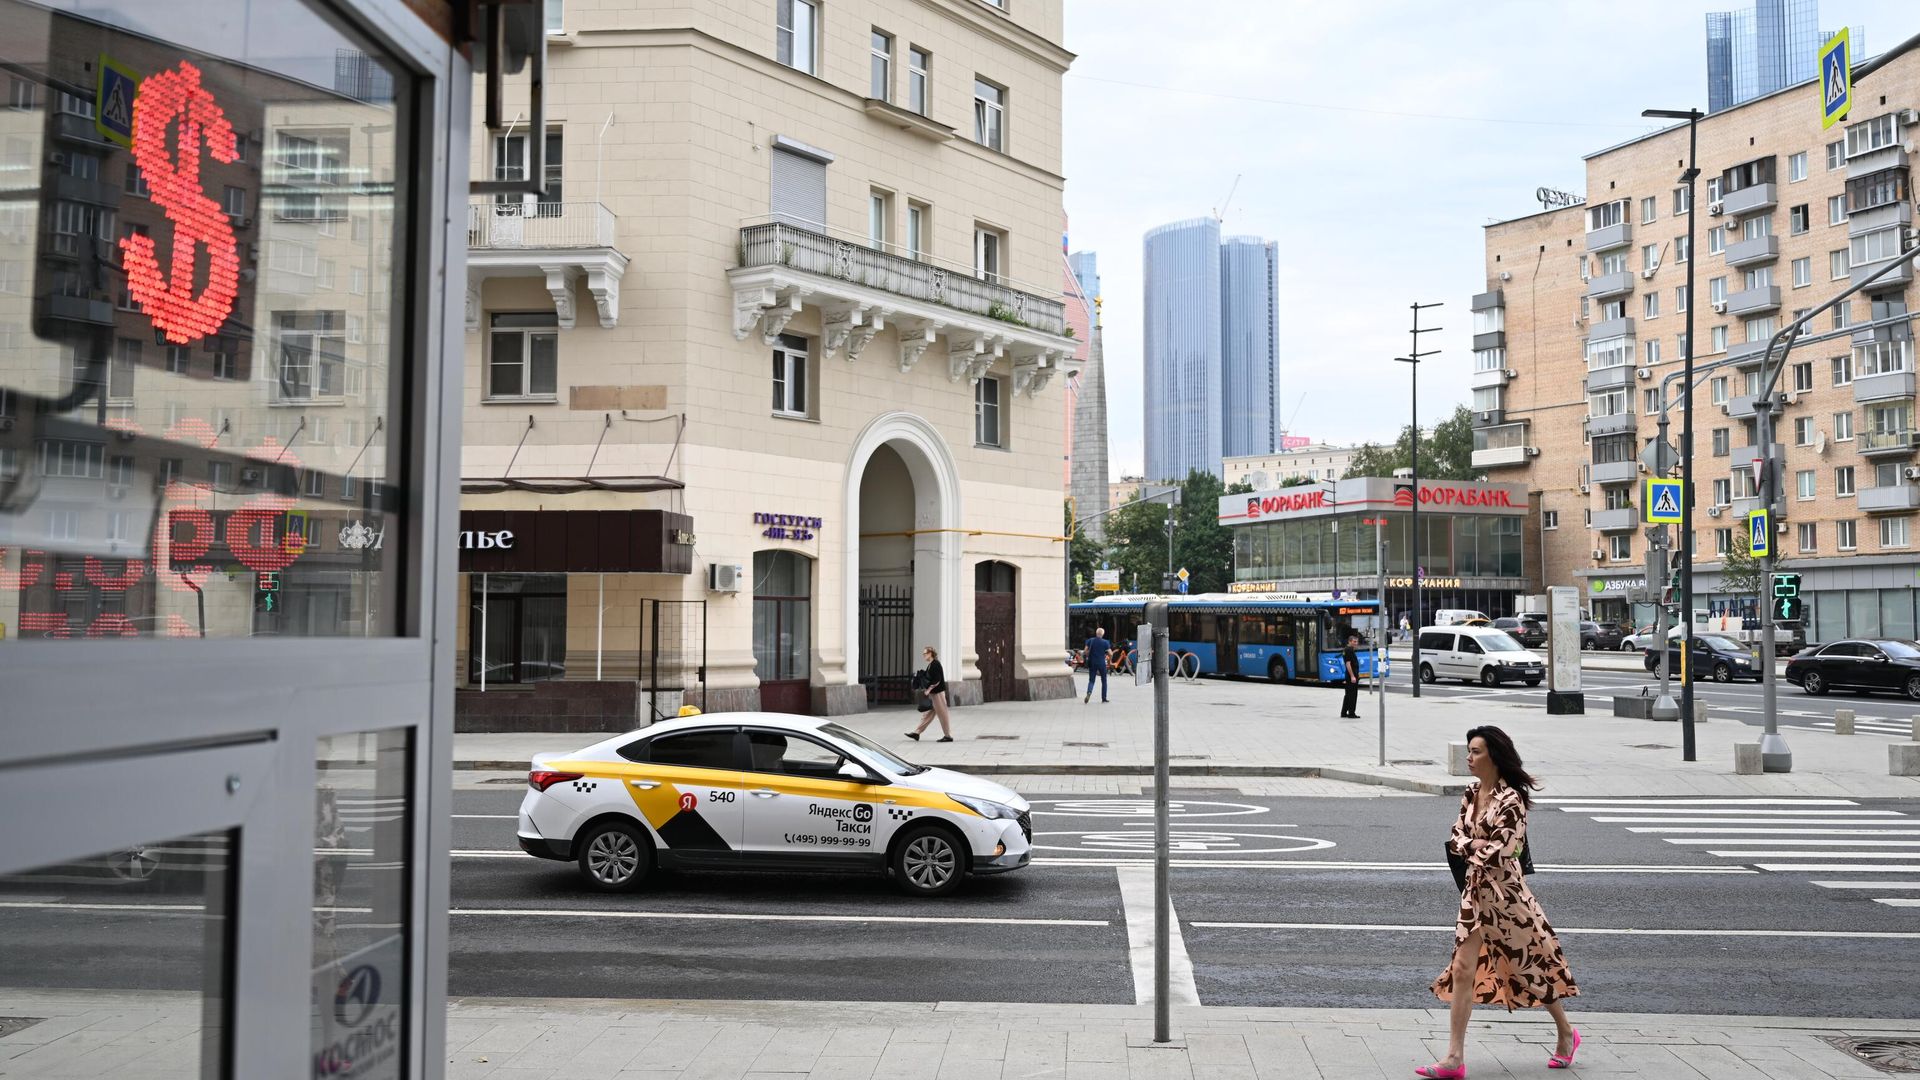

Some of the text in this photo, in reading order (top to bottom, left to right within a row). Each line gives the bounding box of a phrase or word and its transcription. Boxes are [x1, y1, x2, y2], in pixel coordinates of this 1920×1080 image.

[1262, 491, 1325, 513] ФОРАБАНК
[1418, 486, 1511, 507] ФОРАБАНК
[754, 512, 822, 528] ГОСКУРСЫ
[457, 530, 514, 549] лье
[1232, 582, 1277, 593] КОФЕМАНИЯ
[1389, 578, 1461, 588] КОФМАНИЯ
[683, 795, 693, 810] Я
[709, 790, 736, 803] 540
[808, 804, 873, 820] Яндекс Go
[836, 819, 872, 834] Такси
[791, 833, 871, 847] (495) 999-99-99
